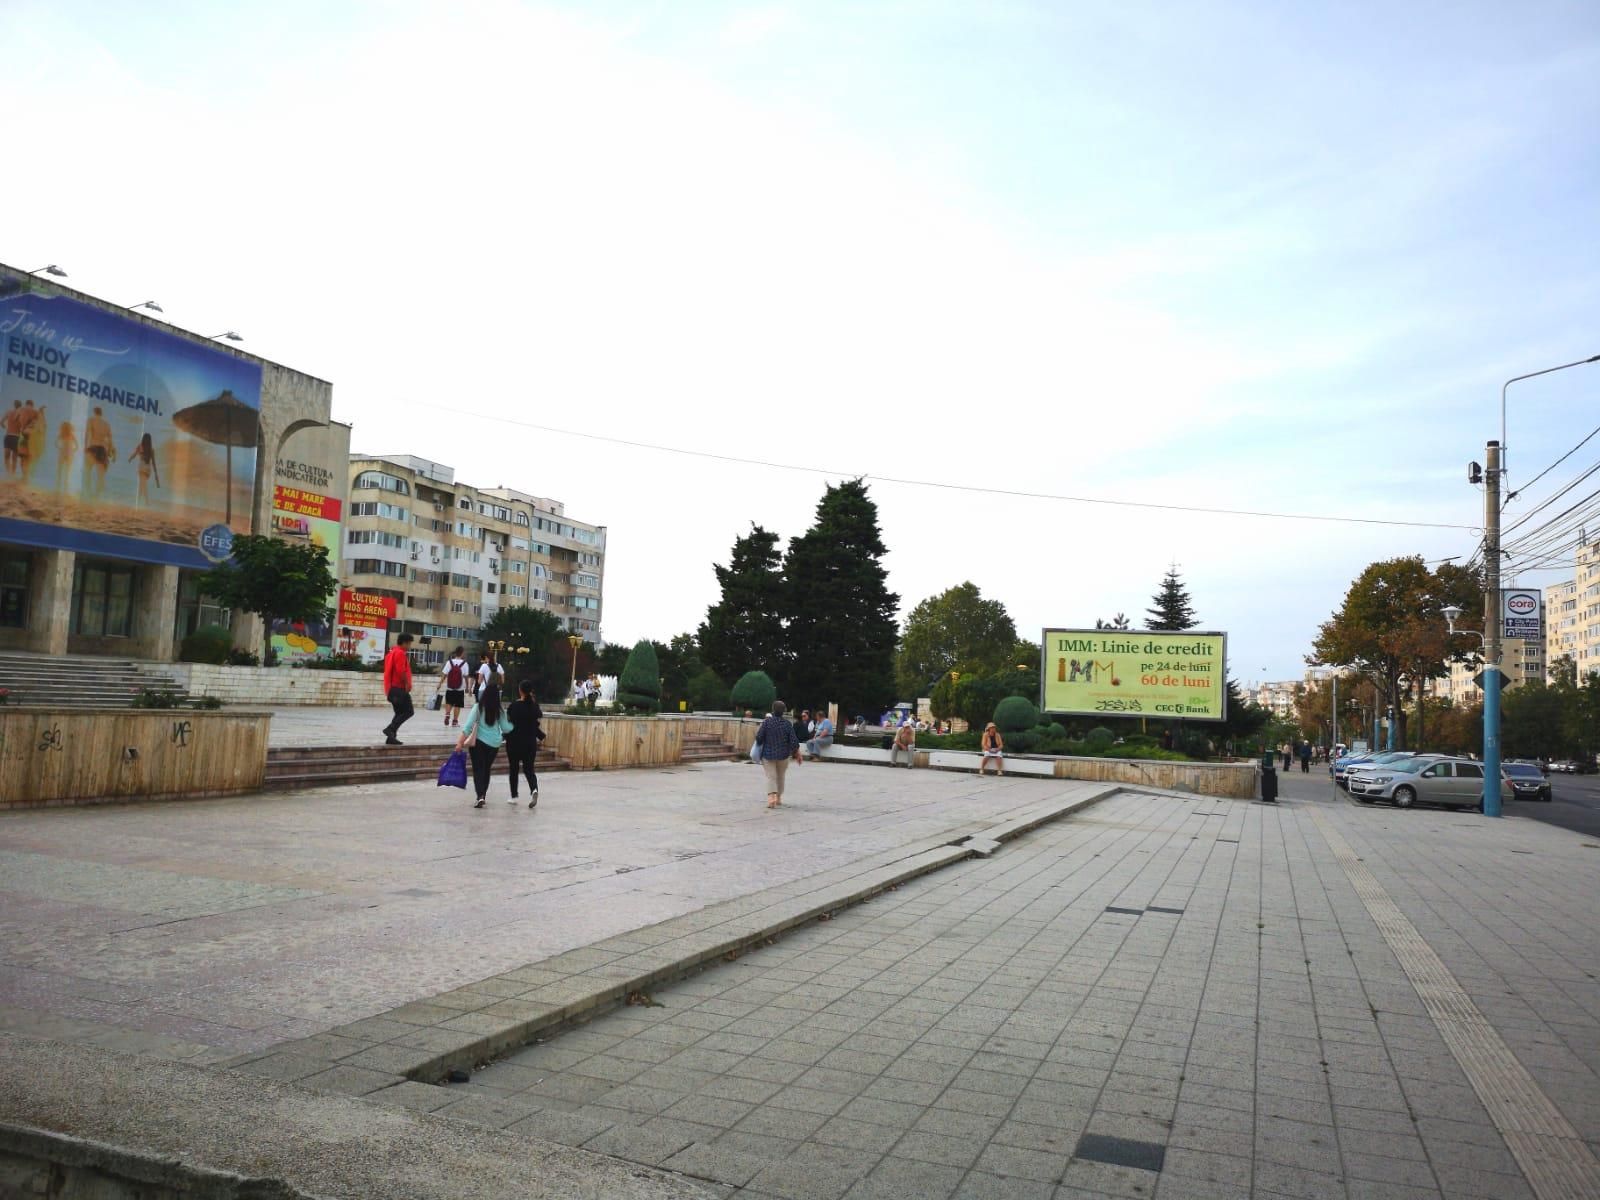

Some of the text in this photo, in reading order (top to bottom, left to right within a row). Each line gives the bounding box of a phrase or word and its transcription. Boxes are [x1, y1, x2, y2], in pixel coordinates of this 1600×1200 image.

[0, 309, 56, 343] Join
[8, 335, 71, 369] ENJOY
[6, 357, 164, 417] MEDITERRANEAN.
[286, 459, 297, 470] DE
[299, 463, 334, 480] CULTURA
[282, 487, 299, 499] MAI
[302, 492, 326, 505] MARE
[284, 501, 295, 511] DE
[203, 535, 233, 551] EFES
[351, 592, 383, 606] CULTURE
[1509, 600, 1534, 608] cora
[343, 602, 388, 617] KIDS ARENA
[1058, 639, 1214, 656] IMM: Linie de credit
[1141, 661, 1211, 673] pe 24 de luni
[1141, 674, 1211, 688] 60 de luni
[1155, 704, 1210, 714] CEC Bank
